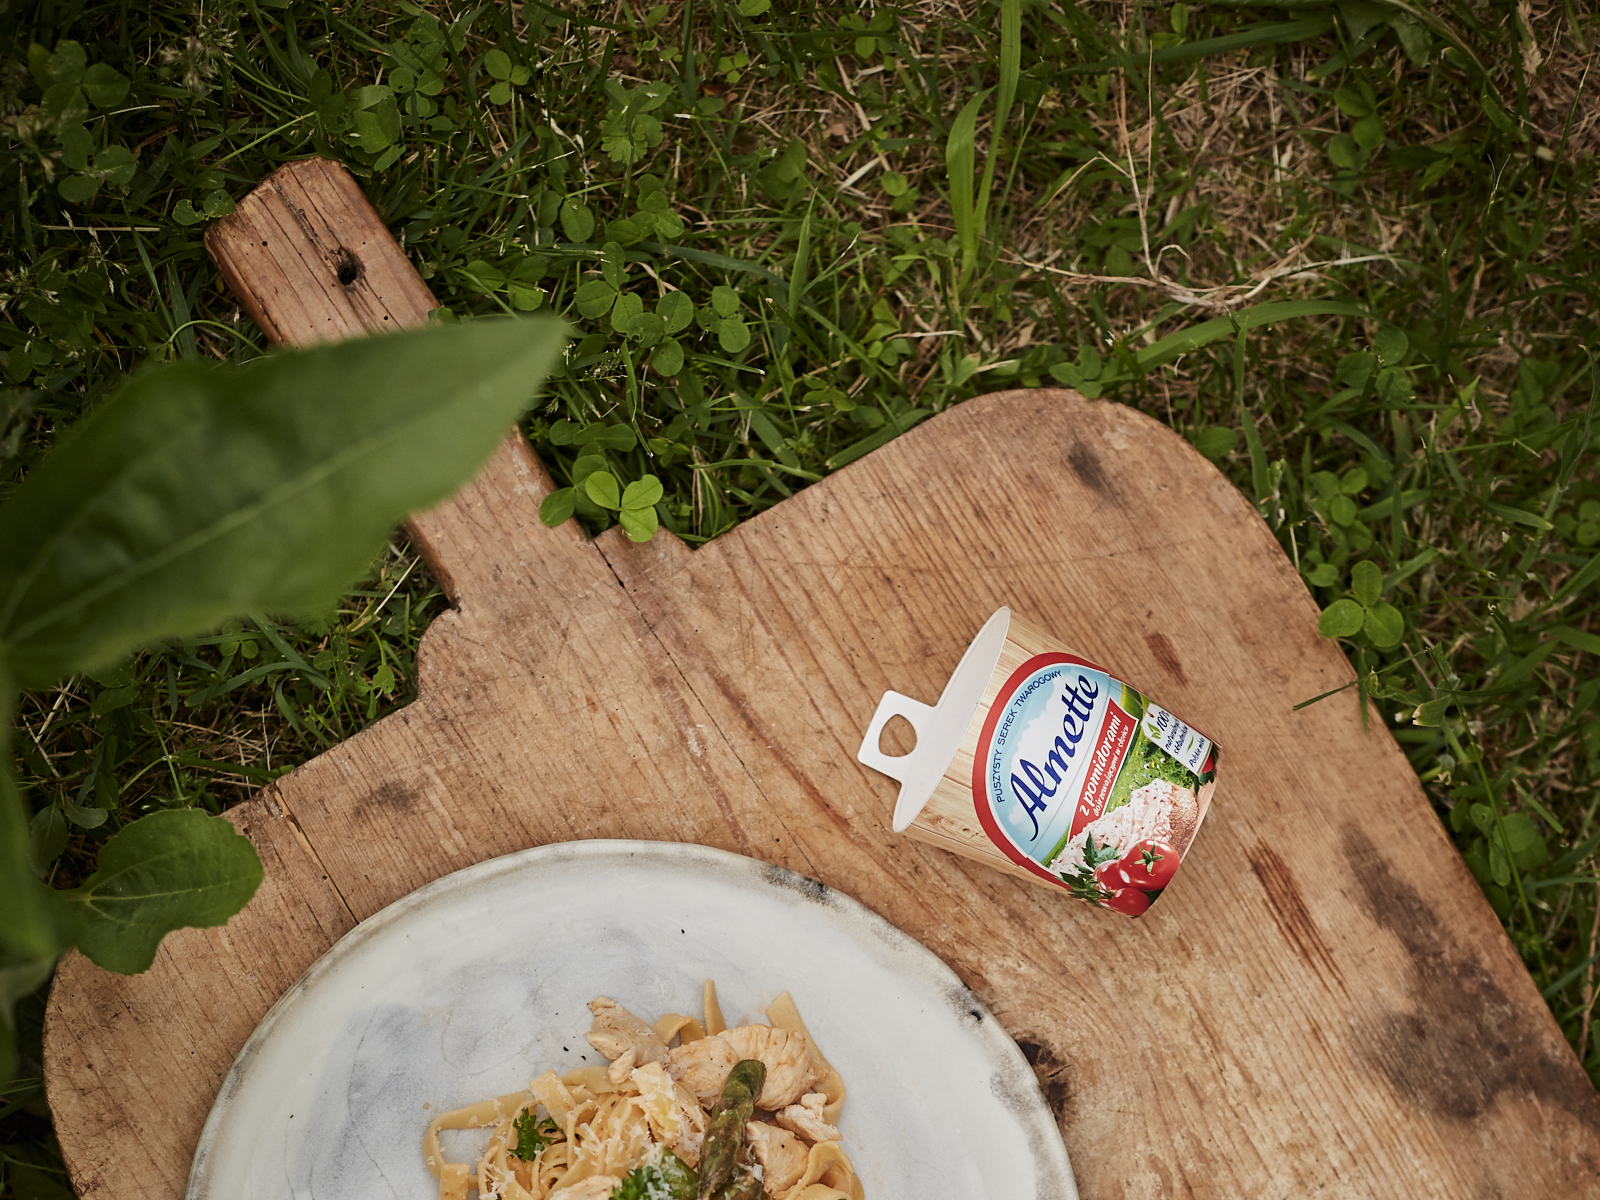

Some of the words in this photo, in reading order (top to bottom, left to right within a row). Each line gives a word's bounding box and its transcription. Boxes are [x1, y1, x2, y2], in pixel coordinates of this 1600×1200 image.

[1014, 670, 1062, 707] TWAROGOWY
[997, 709, 1018, 746] SEREK
[993, 750, 1005, 803] PUSZYSTY
[1010, 675, 1099, 841] Almette
[1083, 711, 1122, 807] pomidorami
[1079, 804, 1090, 817] z
[1093, 753, 1118, 817] dojrzewającymi
